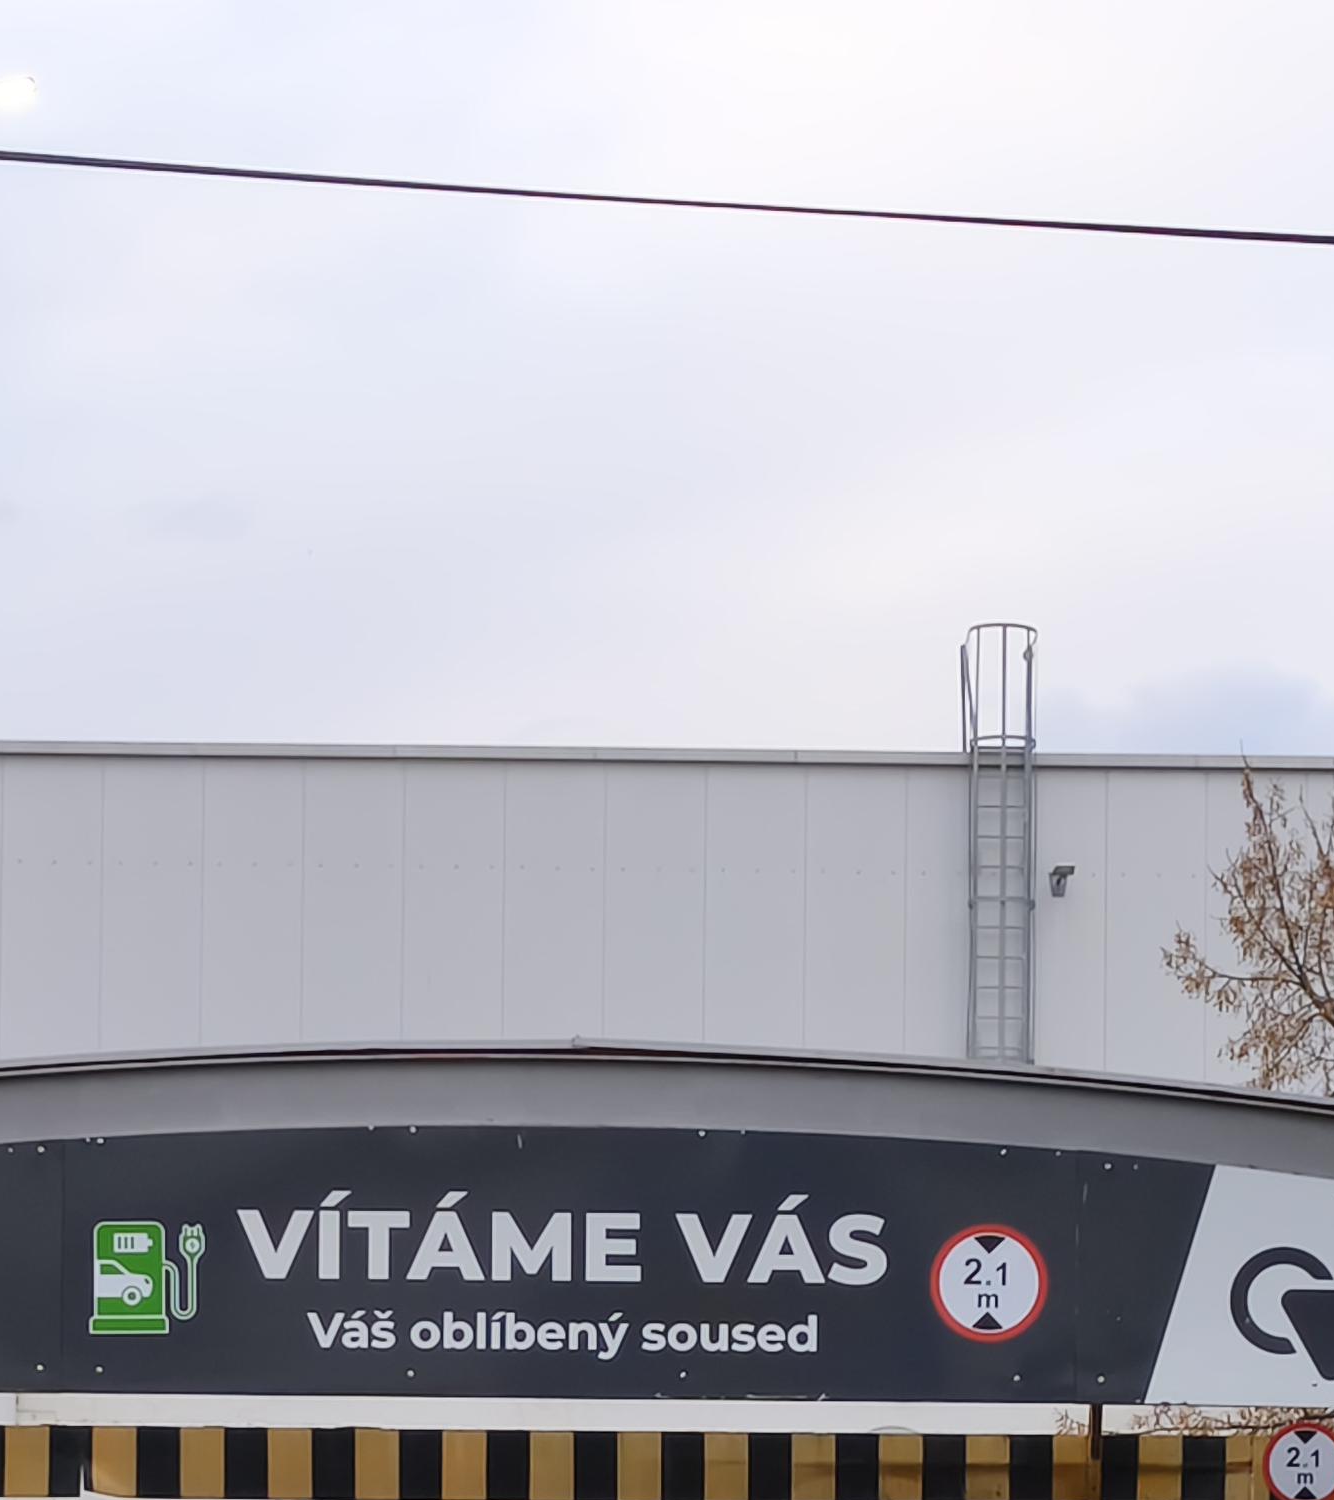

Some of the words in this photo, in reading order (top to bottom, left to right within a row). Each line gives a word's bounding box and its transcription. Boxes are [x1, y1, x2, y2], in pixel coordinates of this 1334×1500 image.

[236, 1189, 643, 1284] VÍTÁME
[675, 1194, 889, 1287] VÁS
[964, 1258, 1007, 1286] 2.1
[978, 1294, 998, 1308] m
[306, 1308, 396, 1351] Váš
[409, 1310, 629, 1361] oblíbený
[640, 1314, 819, 1355] soused
[1297, 1472, 1313, 1484] m
